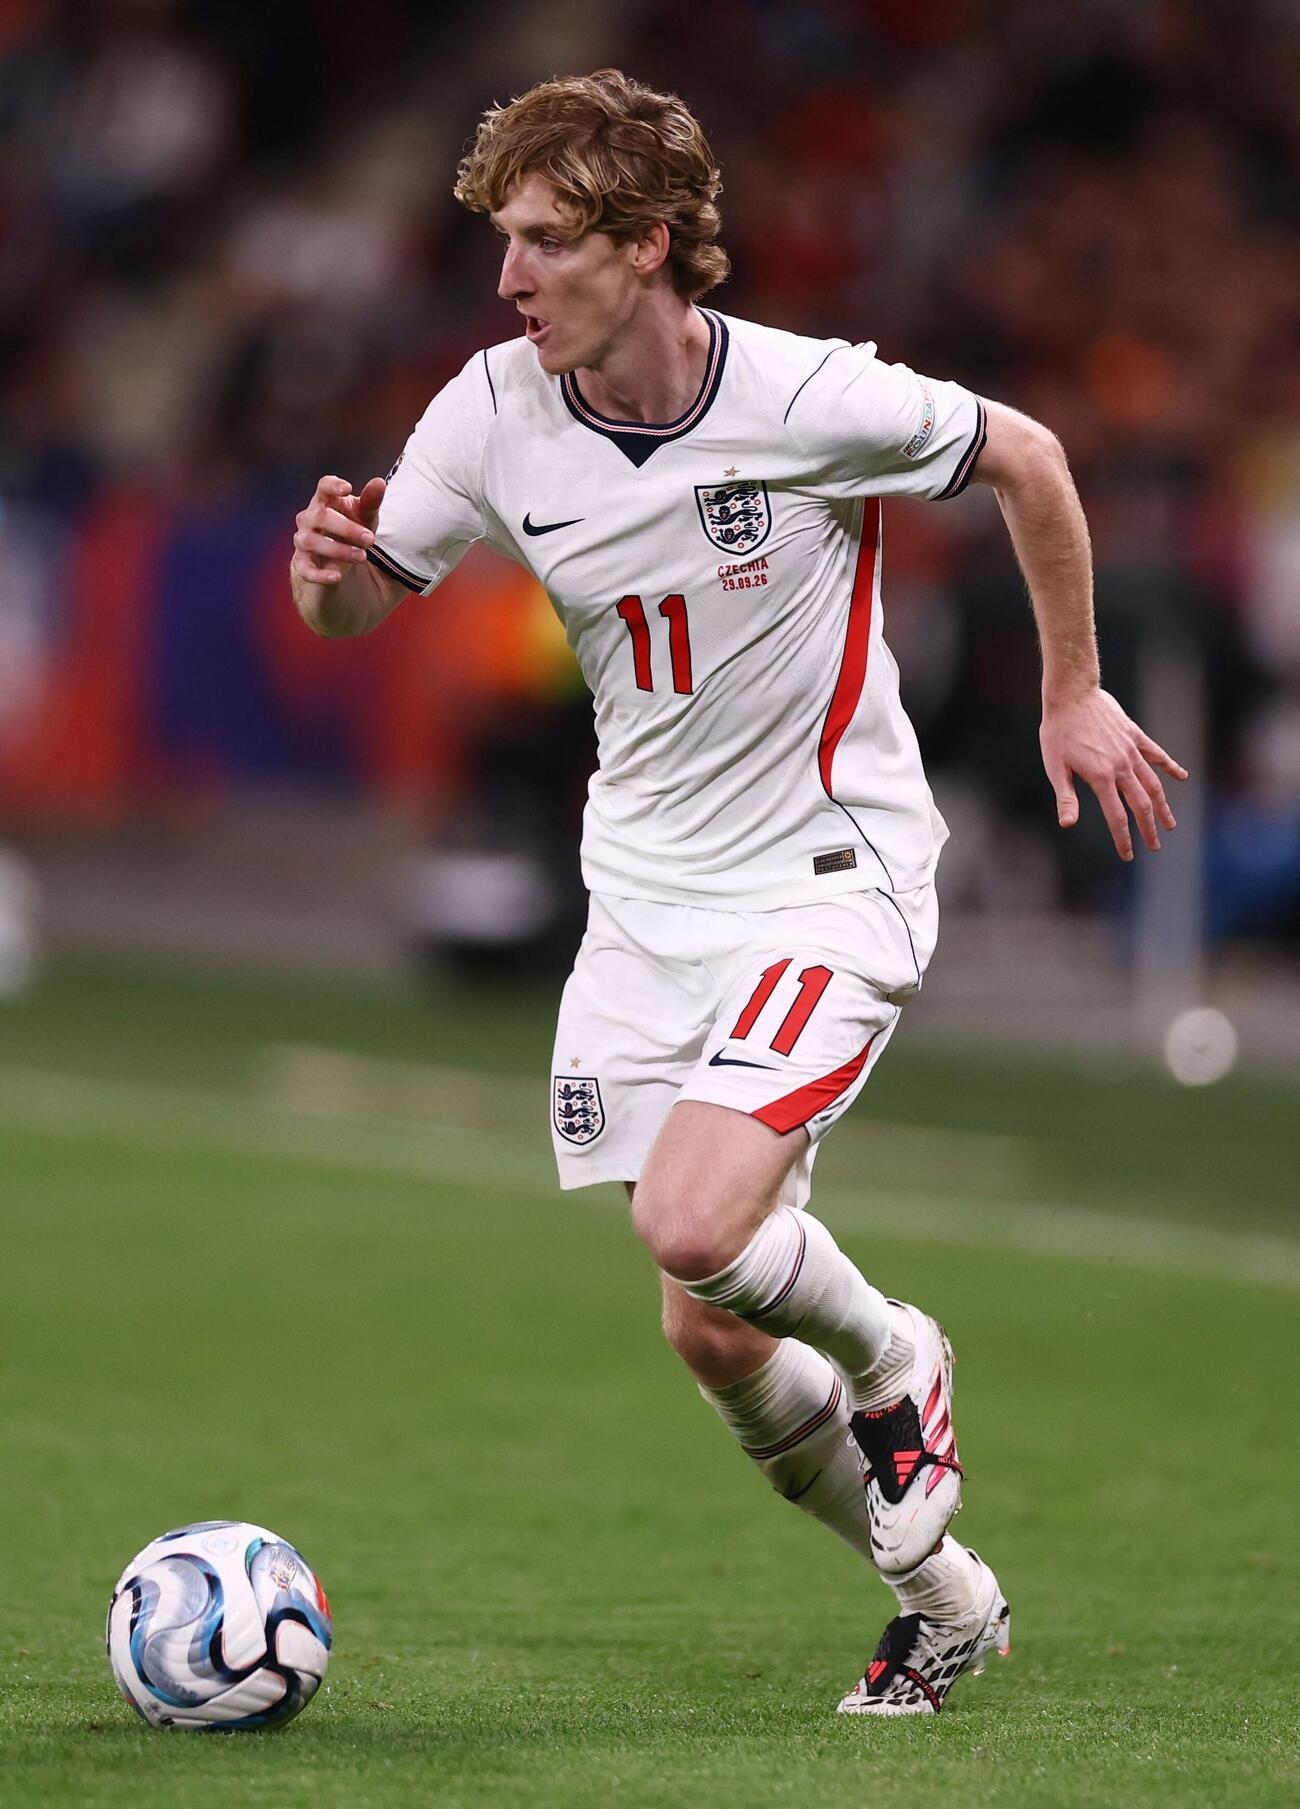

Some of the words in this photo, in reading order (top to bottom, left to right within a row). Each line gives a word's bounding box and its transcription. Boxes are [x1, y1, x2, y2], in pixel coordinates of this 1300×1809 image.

[906, 383, 932, 457] FOUNDA
[718, 557, 769, 578] CZECHIA
[722, 573, 768, 591] 29.09.26
[616, 594, 693, 695] 11
[729, 958, 834, 1057] 11
